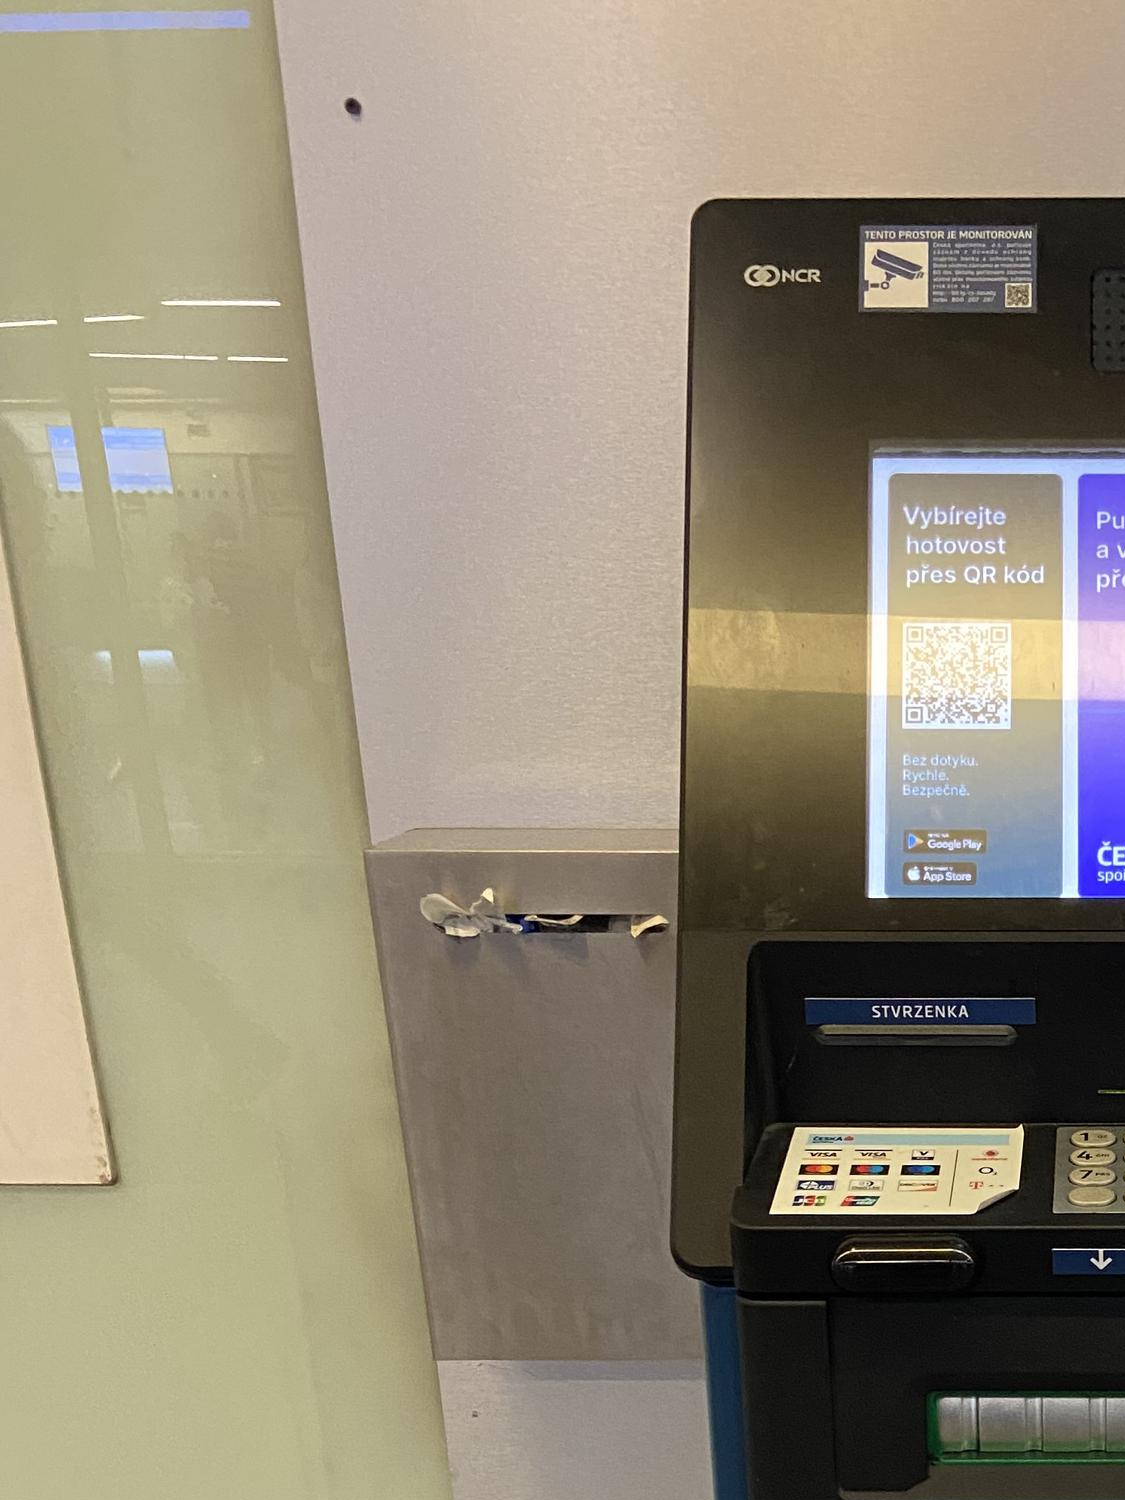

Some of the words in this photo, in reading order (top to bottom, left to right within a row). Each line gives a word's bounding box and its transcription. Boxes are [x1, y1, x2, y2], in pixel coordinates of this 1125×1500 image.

[865, 231, 896, 240] TENTO
[898, 231, 945, 240] PROSTOR
[946, 231, 957, 240] JE
[959, 230, 1033, 240] MONITOROVÁN
[781, 268, 822, 283] NCR
[903, 504, 1008, 531] Vybírejte
[905, 535, 1008, 555] hotovost
[1096, 543, 1109, 559] a
[905, 563, 957, 589] přes
[963, 565, 997, 585] QR
[1003, 564, 1046, 585] kód
[902, 753, 928, 767] Bez
[930, 753, 979, 769] dotyku.
[902, 768, 950, 784] Rychle.
[902, 783, 971, 799] Bezpečně.
[927, 838, 962, 852] Google
[962, 838, 983, 852] Play
[923, 871, 944, 883] App
[945, 870, 973, 882] Store
[871, 1004, 970, 1019] STVRZENKA
[1080, 1132, 1090, 1141] 1
[1077, 1151, 1093, 1160] 4
[1079, 1169, 1093, 1179] 7
